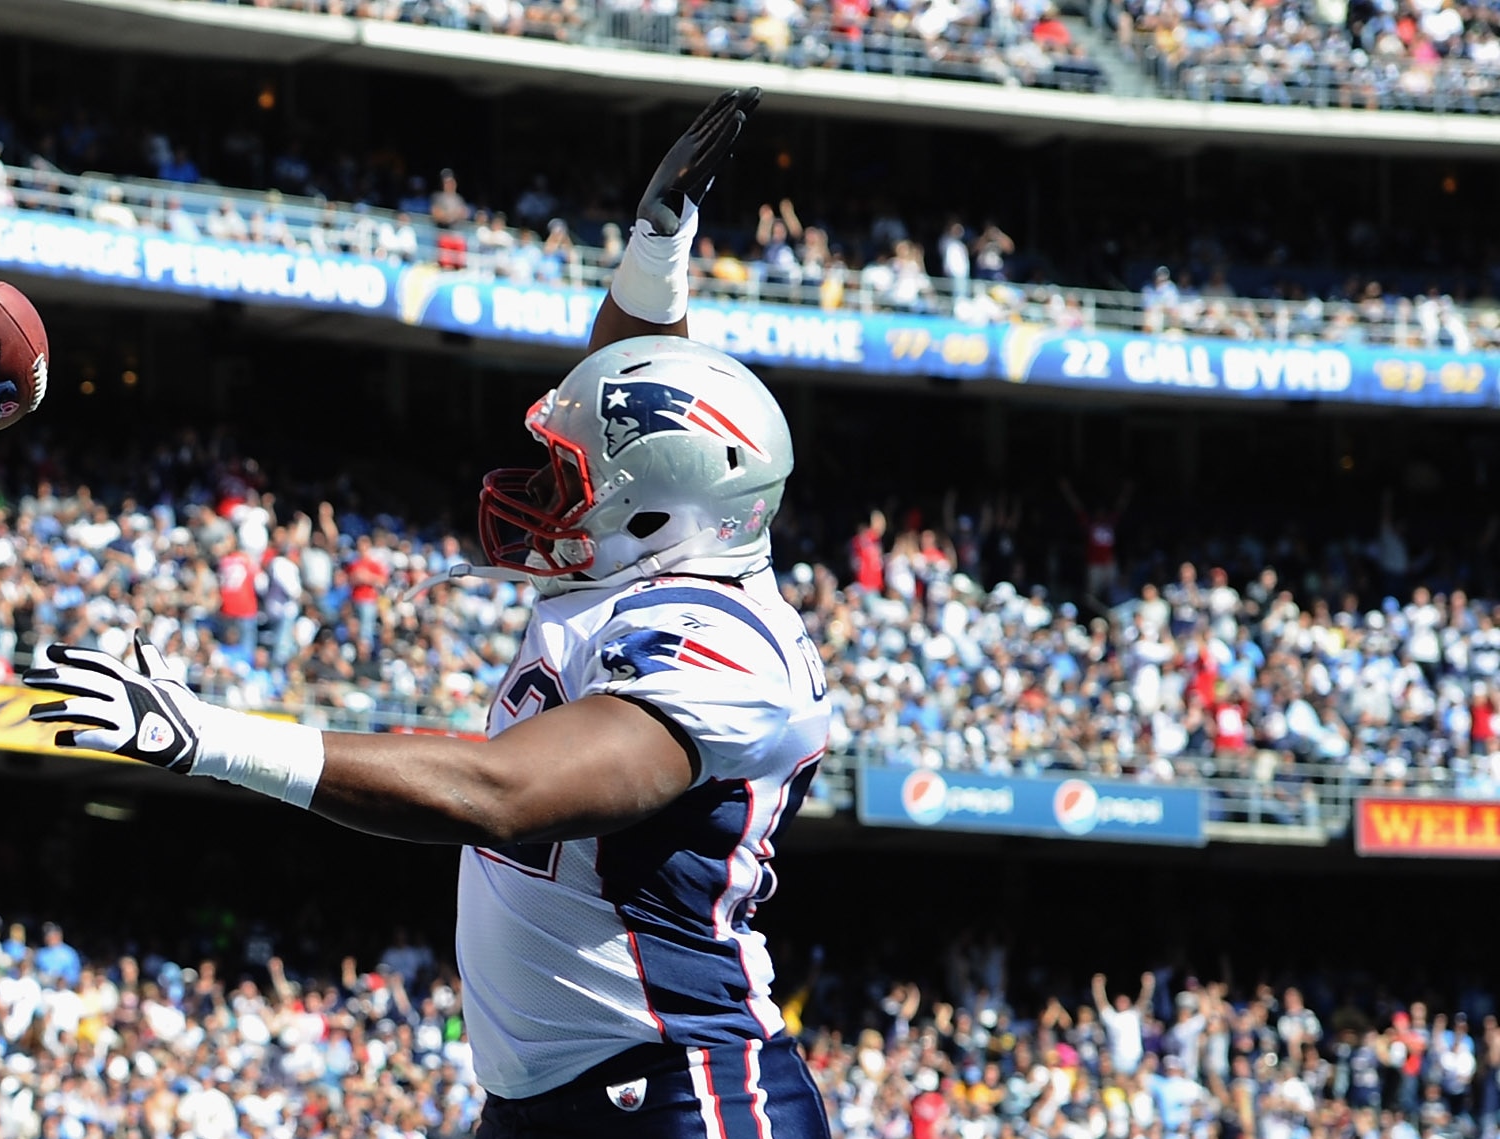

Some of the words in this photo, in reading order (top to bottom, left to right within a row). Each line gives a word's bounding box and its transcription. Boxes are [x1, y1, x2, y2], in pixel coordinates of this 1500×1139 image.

[1062, 338, 1111, 379] 22
[1122, 340, 1219, 389] GILL
[1221, 345, 1352, 392] BYRD
